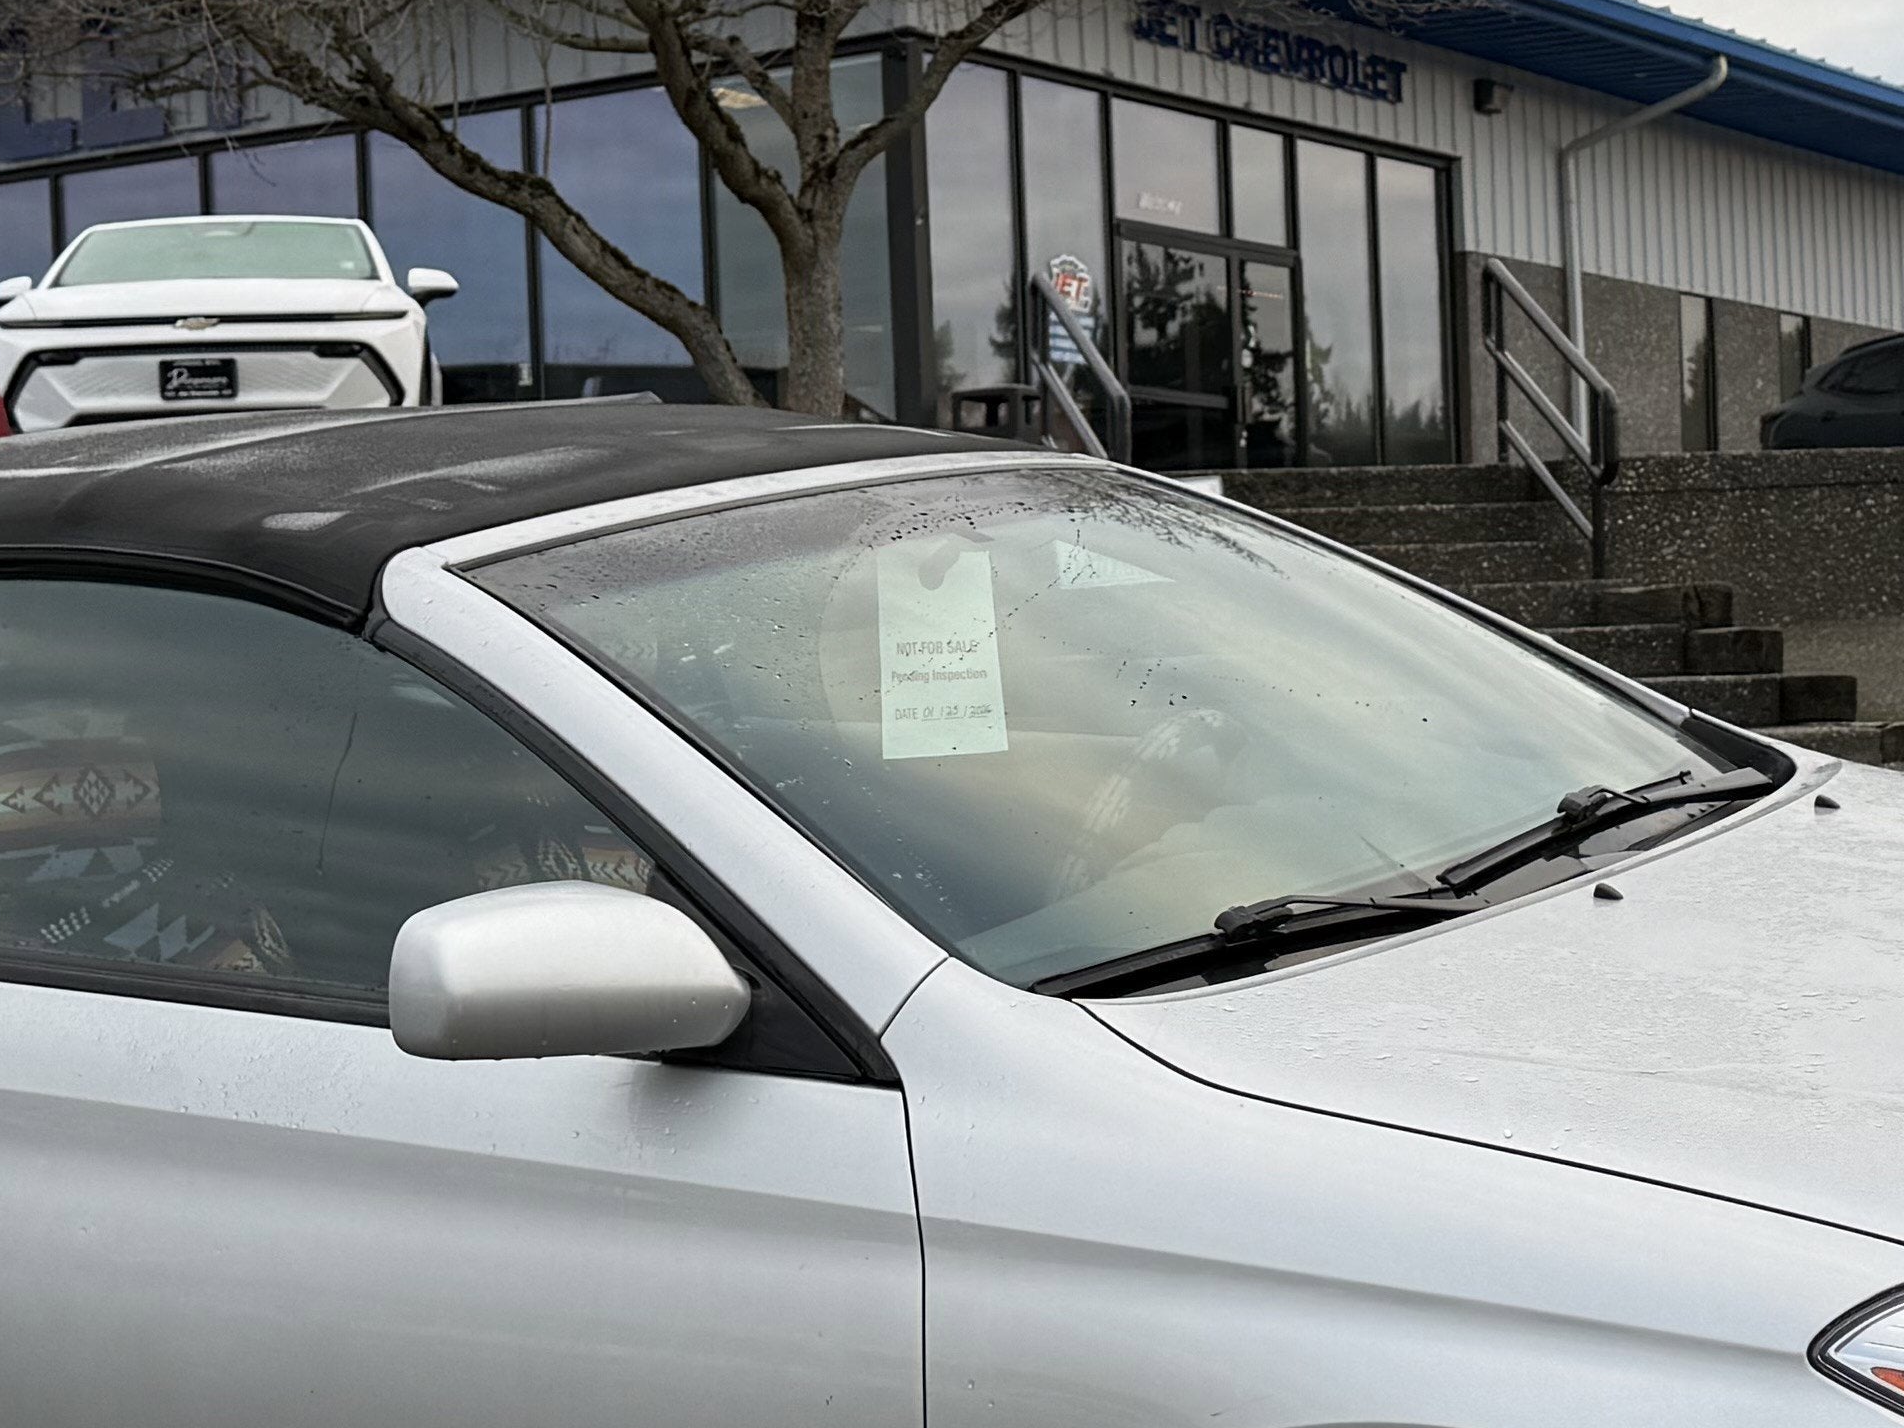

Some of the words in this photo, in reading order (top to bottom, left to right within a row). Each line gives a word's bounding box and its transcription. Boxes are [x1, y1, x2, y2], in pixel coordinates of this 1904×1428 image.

[1208, 12, 1407, 103] CHEVROLET
[896, 641, 918, 656] NOT
[920, 640, 944, 655] FOR
[946, 638, 979, 653] SALE
[895, 707, 919, 720] DATE
